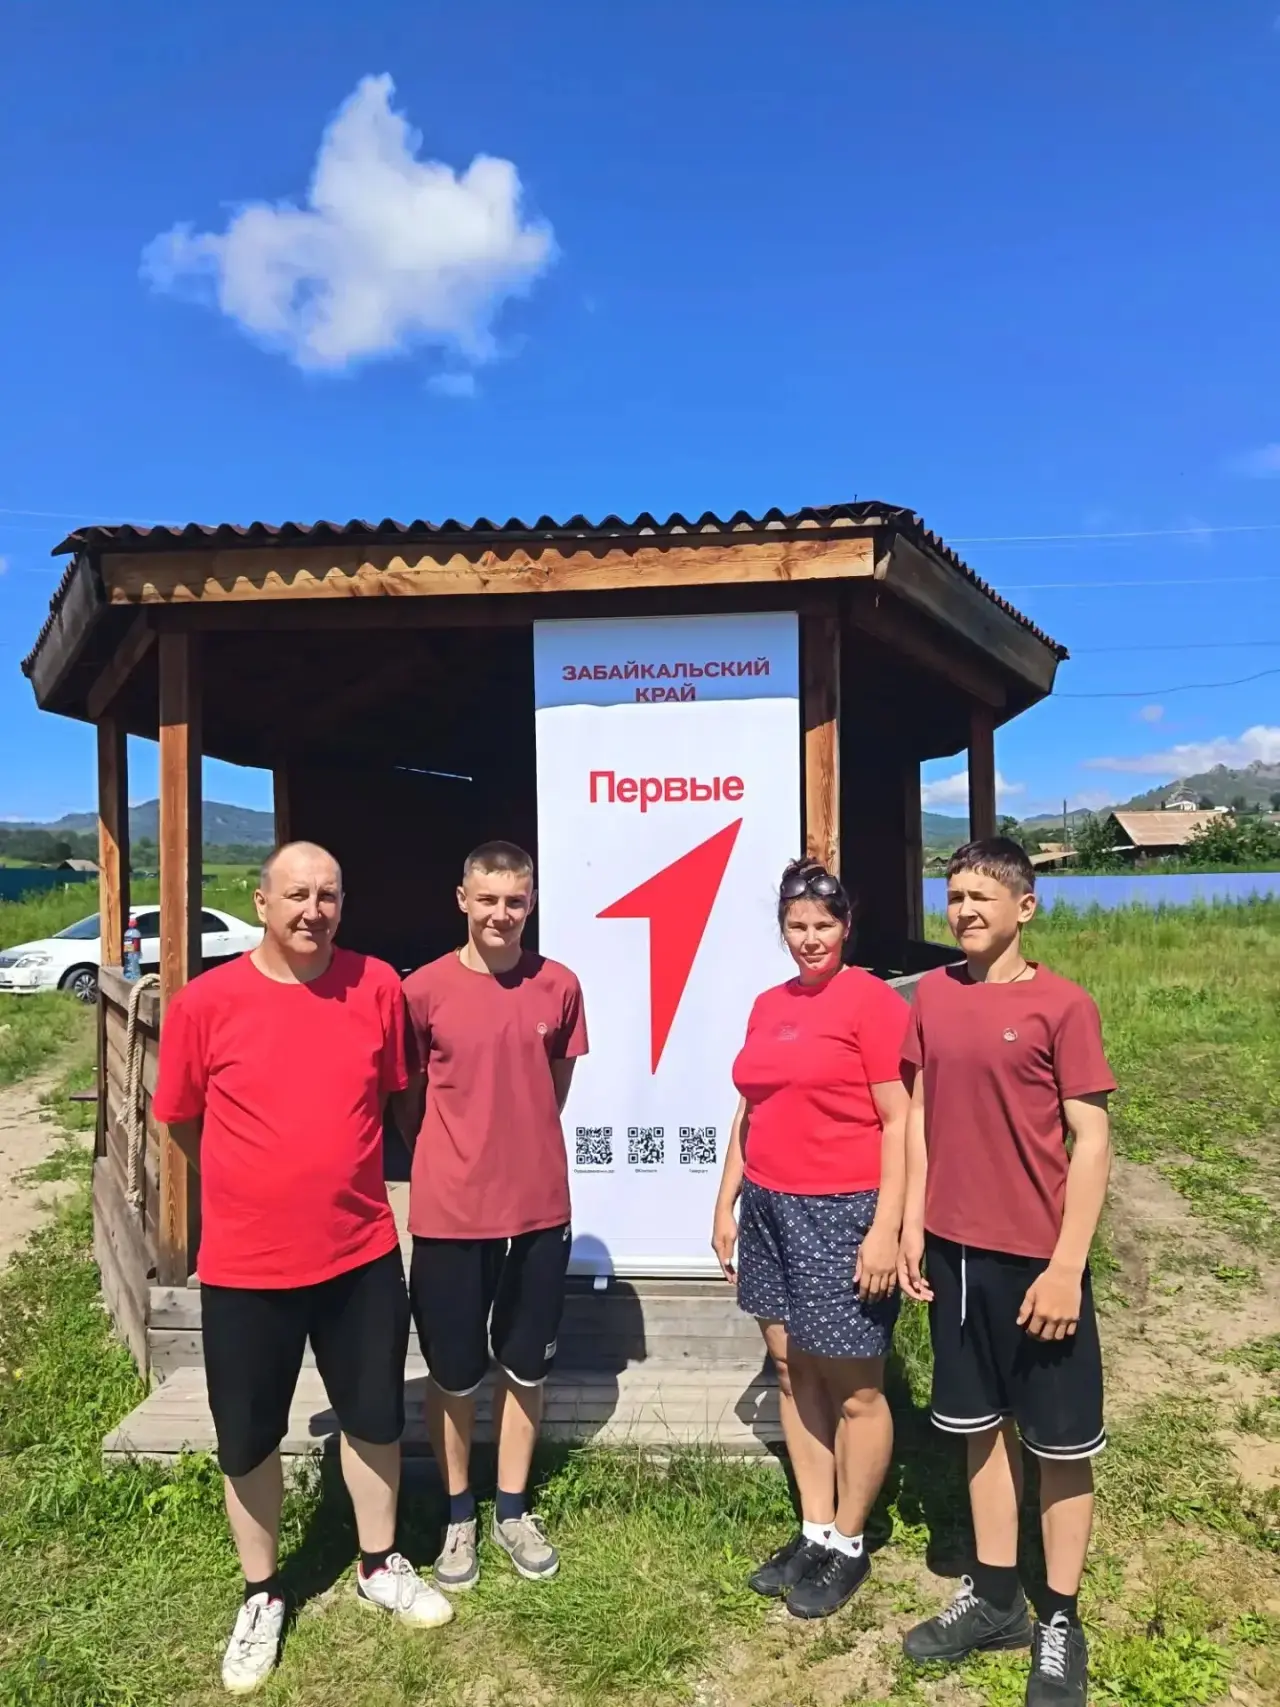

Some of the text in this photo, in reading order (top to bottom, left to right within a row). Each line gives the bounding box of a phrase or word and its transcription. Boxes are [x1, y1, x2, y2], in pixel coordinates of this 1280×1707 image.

[562, 657, 770, 681] ЗАБАЙКАЛЬСКИЙ
[635, 683, 696, 702] КРАЙ
[590, 771, 744, 813] Первые
